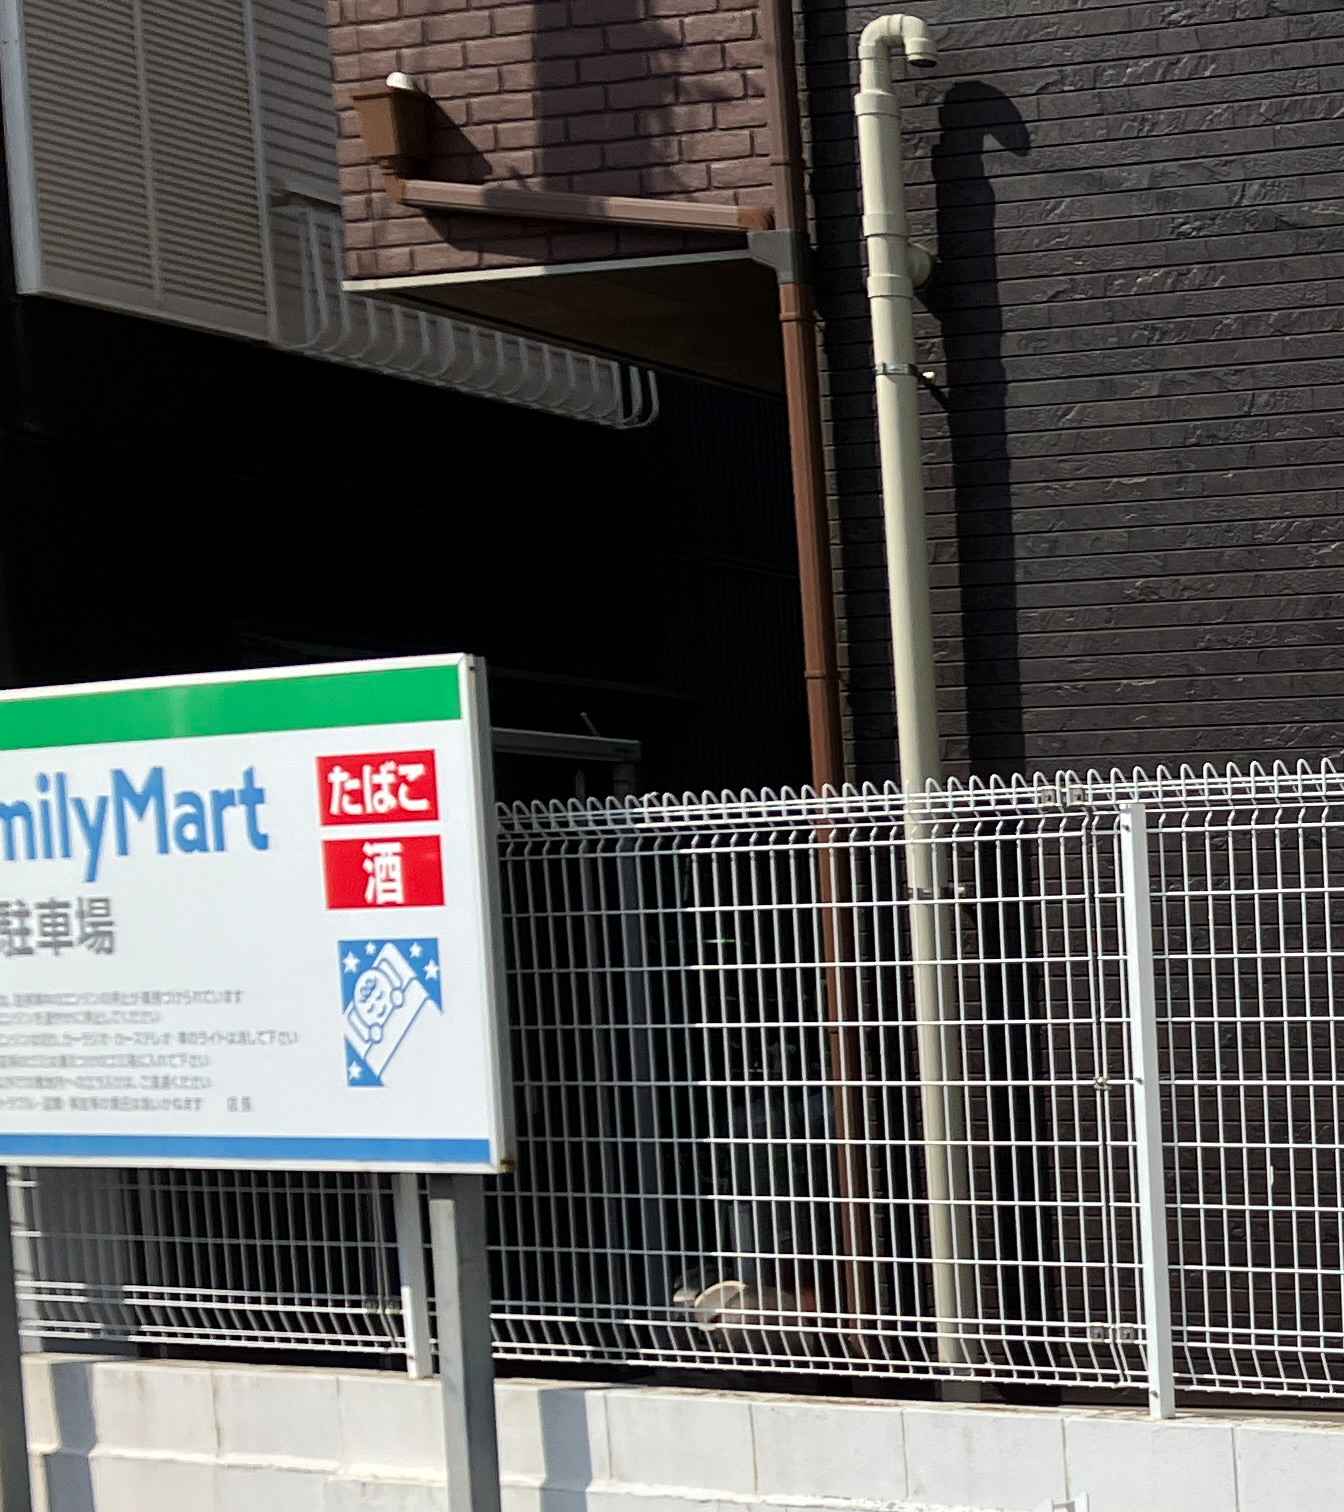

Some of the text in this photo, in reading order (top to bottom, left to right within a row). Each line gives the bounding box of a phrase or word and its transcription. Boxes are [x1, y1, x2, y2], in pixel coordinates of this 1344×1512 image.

[327, 759, 430, 816] たばこ
[0, 767, 269, 882] milyMart
[362, 842, 405, 906] 酒
